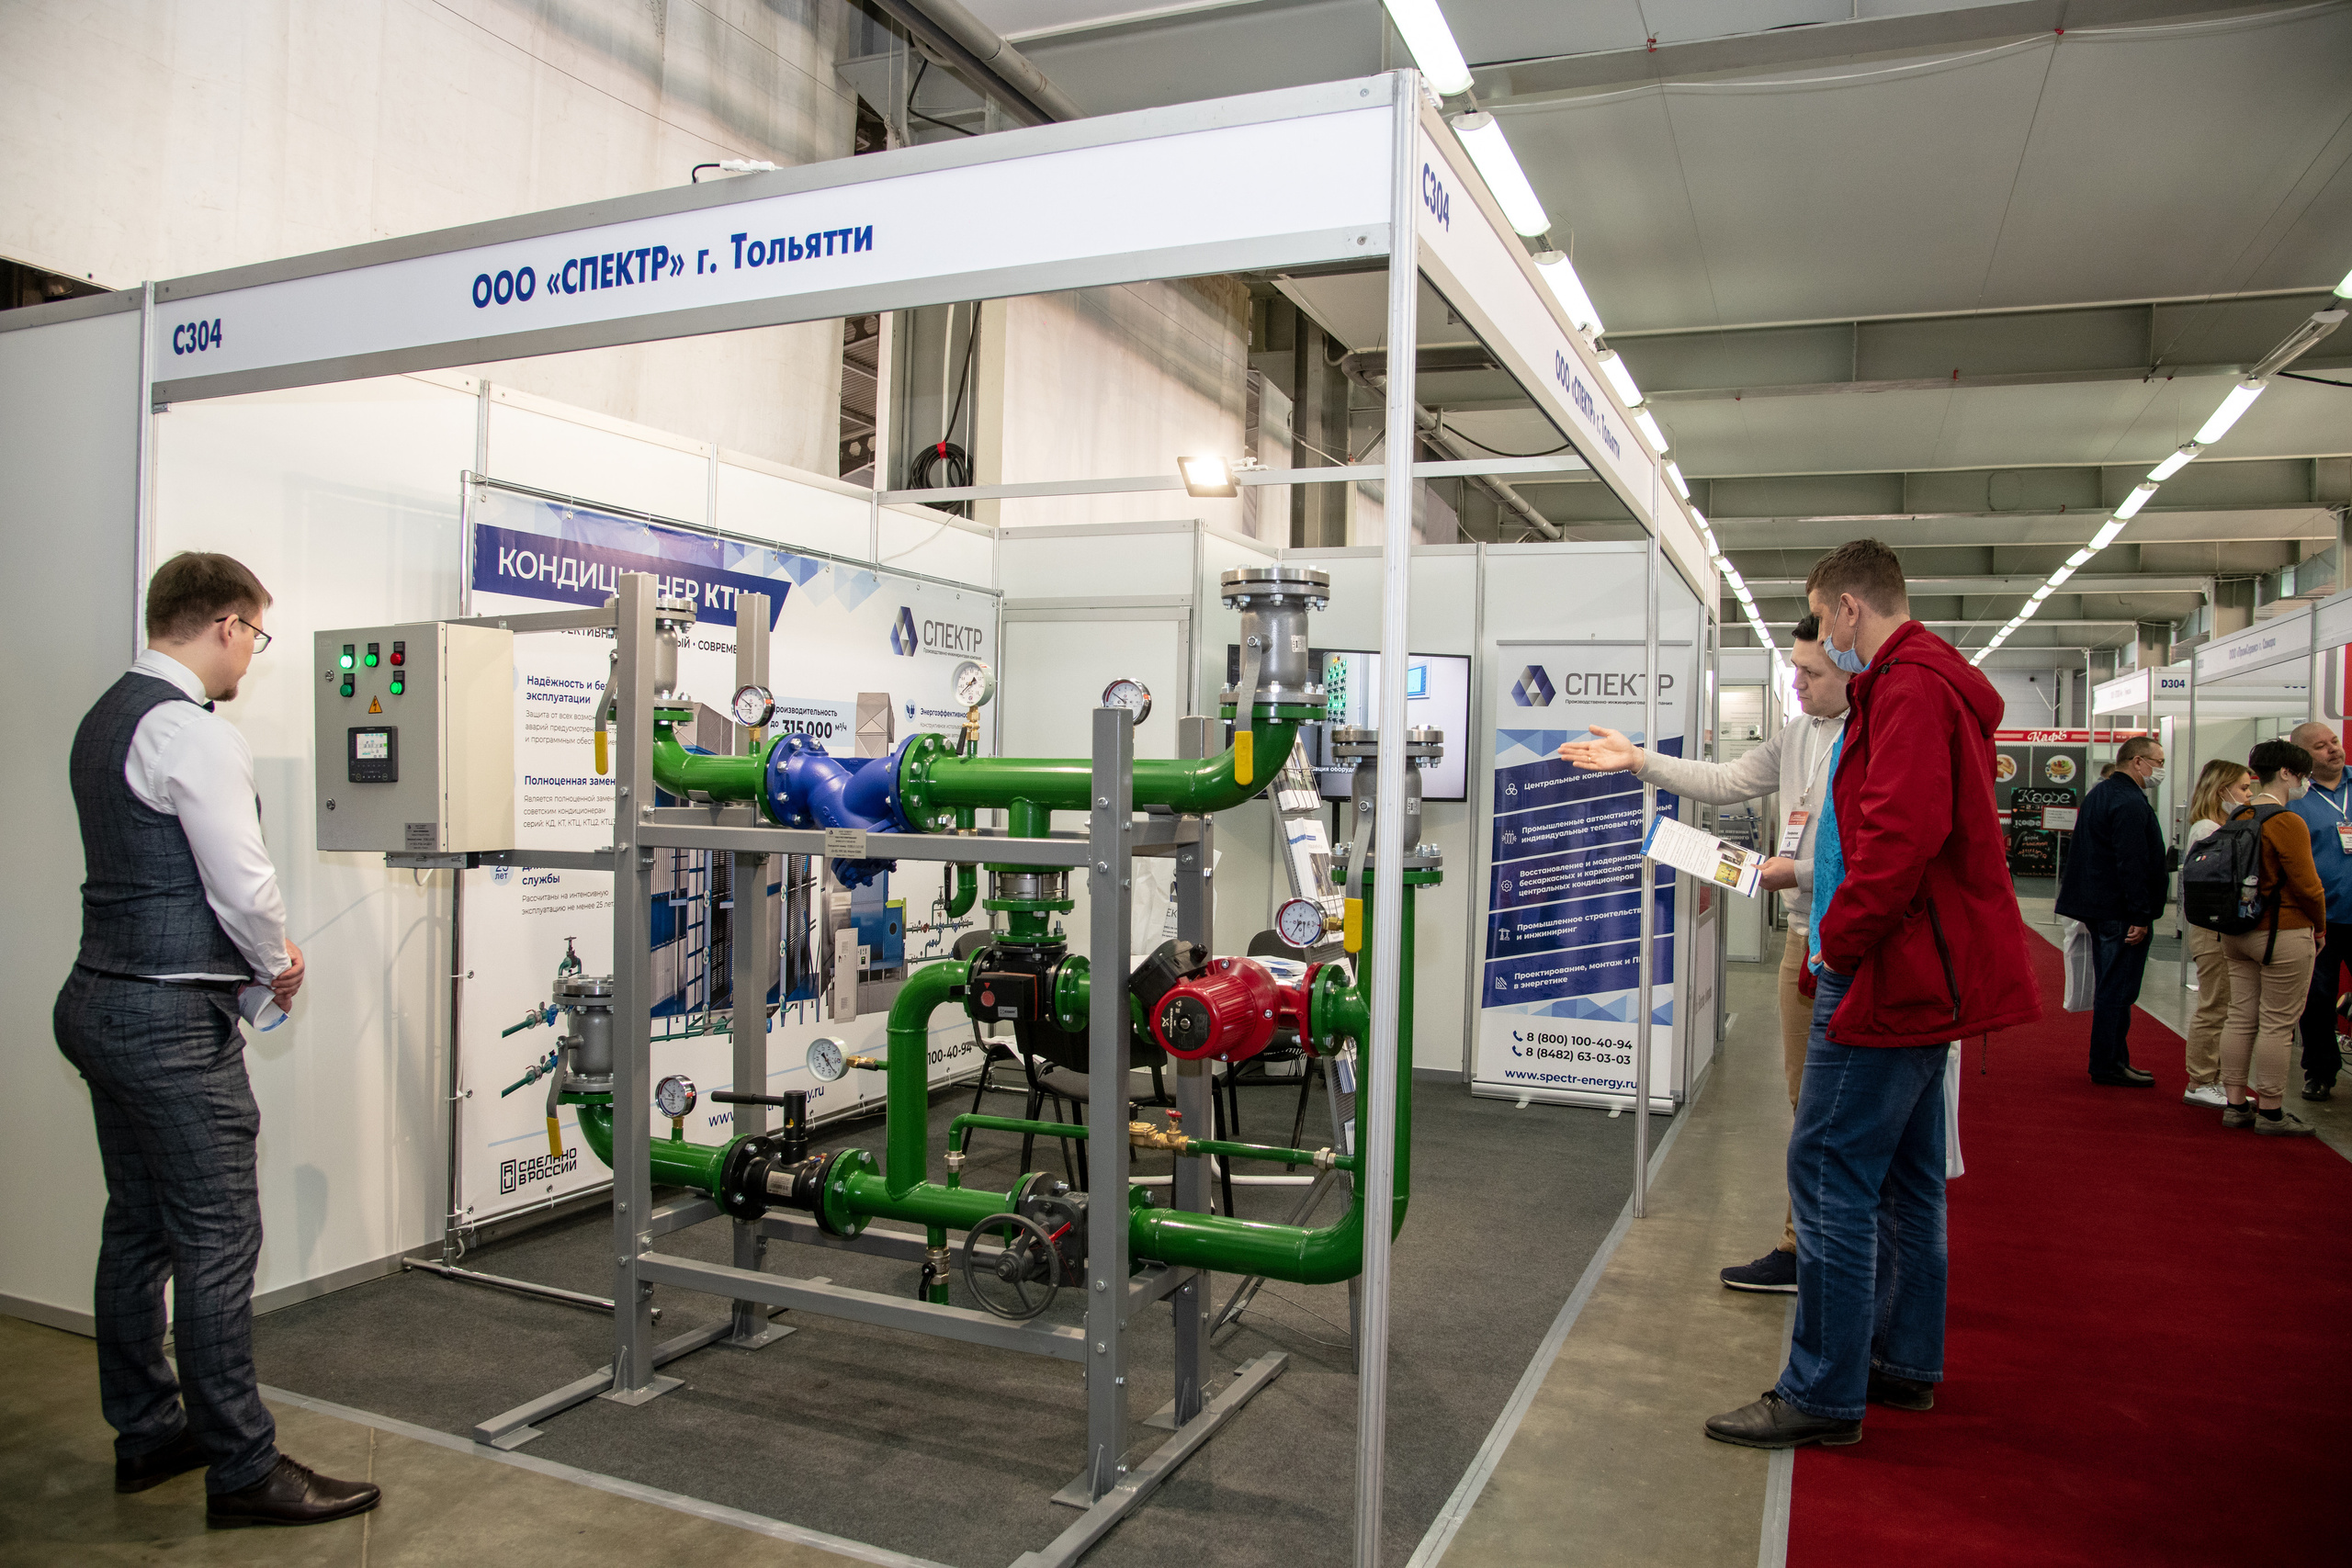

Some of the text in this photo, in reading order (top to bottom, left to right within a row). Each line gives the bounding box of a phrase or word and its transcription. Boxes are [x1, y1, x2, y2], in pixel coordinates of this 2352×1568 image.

[1423, 163, 1450, 232] C304
[472, 225, 873, 309] ООО «СПЕКТР» г. Тольятти
[173, 318, 222, 355] C304
[1555, 349, 1569, 393] ООО
[498, 547, 761, 612] КОНДИЦНЕР КТ
[923, 619, 983, 652] СПЕКТР
[526, 675, 584, 689] Надёжность
[2161, 680, 2185, 688] D304
[526, 692, 591, 705] эксплуатации
[526, 710, 549, 720] Защита
[775, 705, 838, 716] роизводительность
[526, 722, 548, 731] аварий
[770, 720, 779, 728] до
[531, 737, 575, 745] программным
[524, 775, 616, 786] Полноценная замен
[1524, 775, 1580, 790] Центральные
[559, 807, 606, 816] кондиционерам
[524, 819, 544, 829] серий:
[1521, 818, 1584, 834] Промышленные
[1521, 818, 1643, 843] индивидуальные тепловые пун
[1520, 862, 1584, 878] Восстановление
[1593, 852, 1643, 866] модернизац
[522, 874, 560, 887] службы
[1519, 874, 1634, 897] центральных кондиционеров
[1520, 874, 1575, 887] бескаркасных
[522, 894, 559, 902] Рассчитаны
[570, 889, 608, 898] интенсивную
[522, 906, 566, 915] эксплуатацию
[1518, 908, 1642, 931] Промышленное строительств
[1523, 926, 1577, 939] инжиниринг
[1514, 964, 1588, 981] Проектирование,
[1589, 959, 1623, 970] монтаж
[1521, 976, 1567, 988] энергетике
[1527, 1032, 1633, 1049] 8 (800) 100-40-94
[928, 1043, 972, 1066] 100-40-94
[1525, 1047, 1631, 1065] 8 (8482) 63-03-03
[1505, 1070, 1637, 1089] www.spectr-energy.ru
